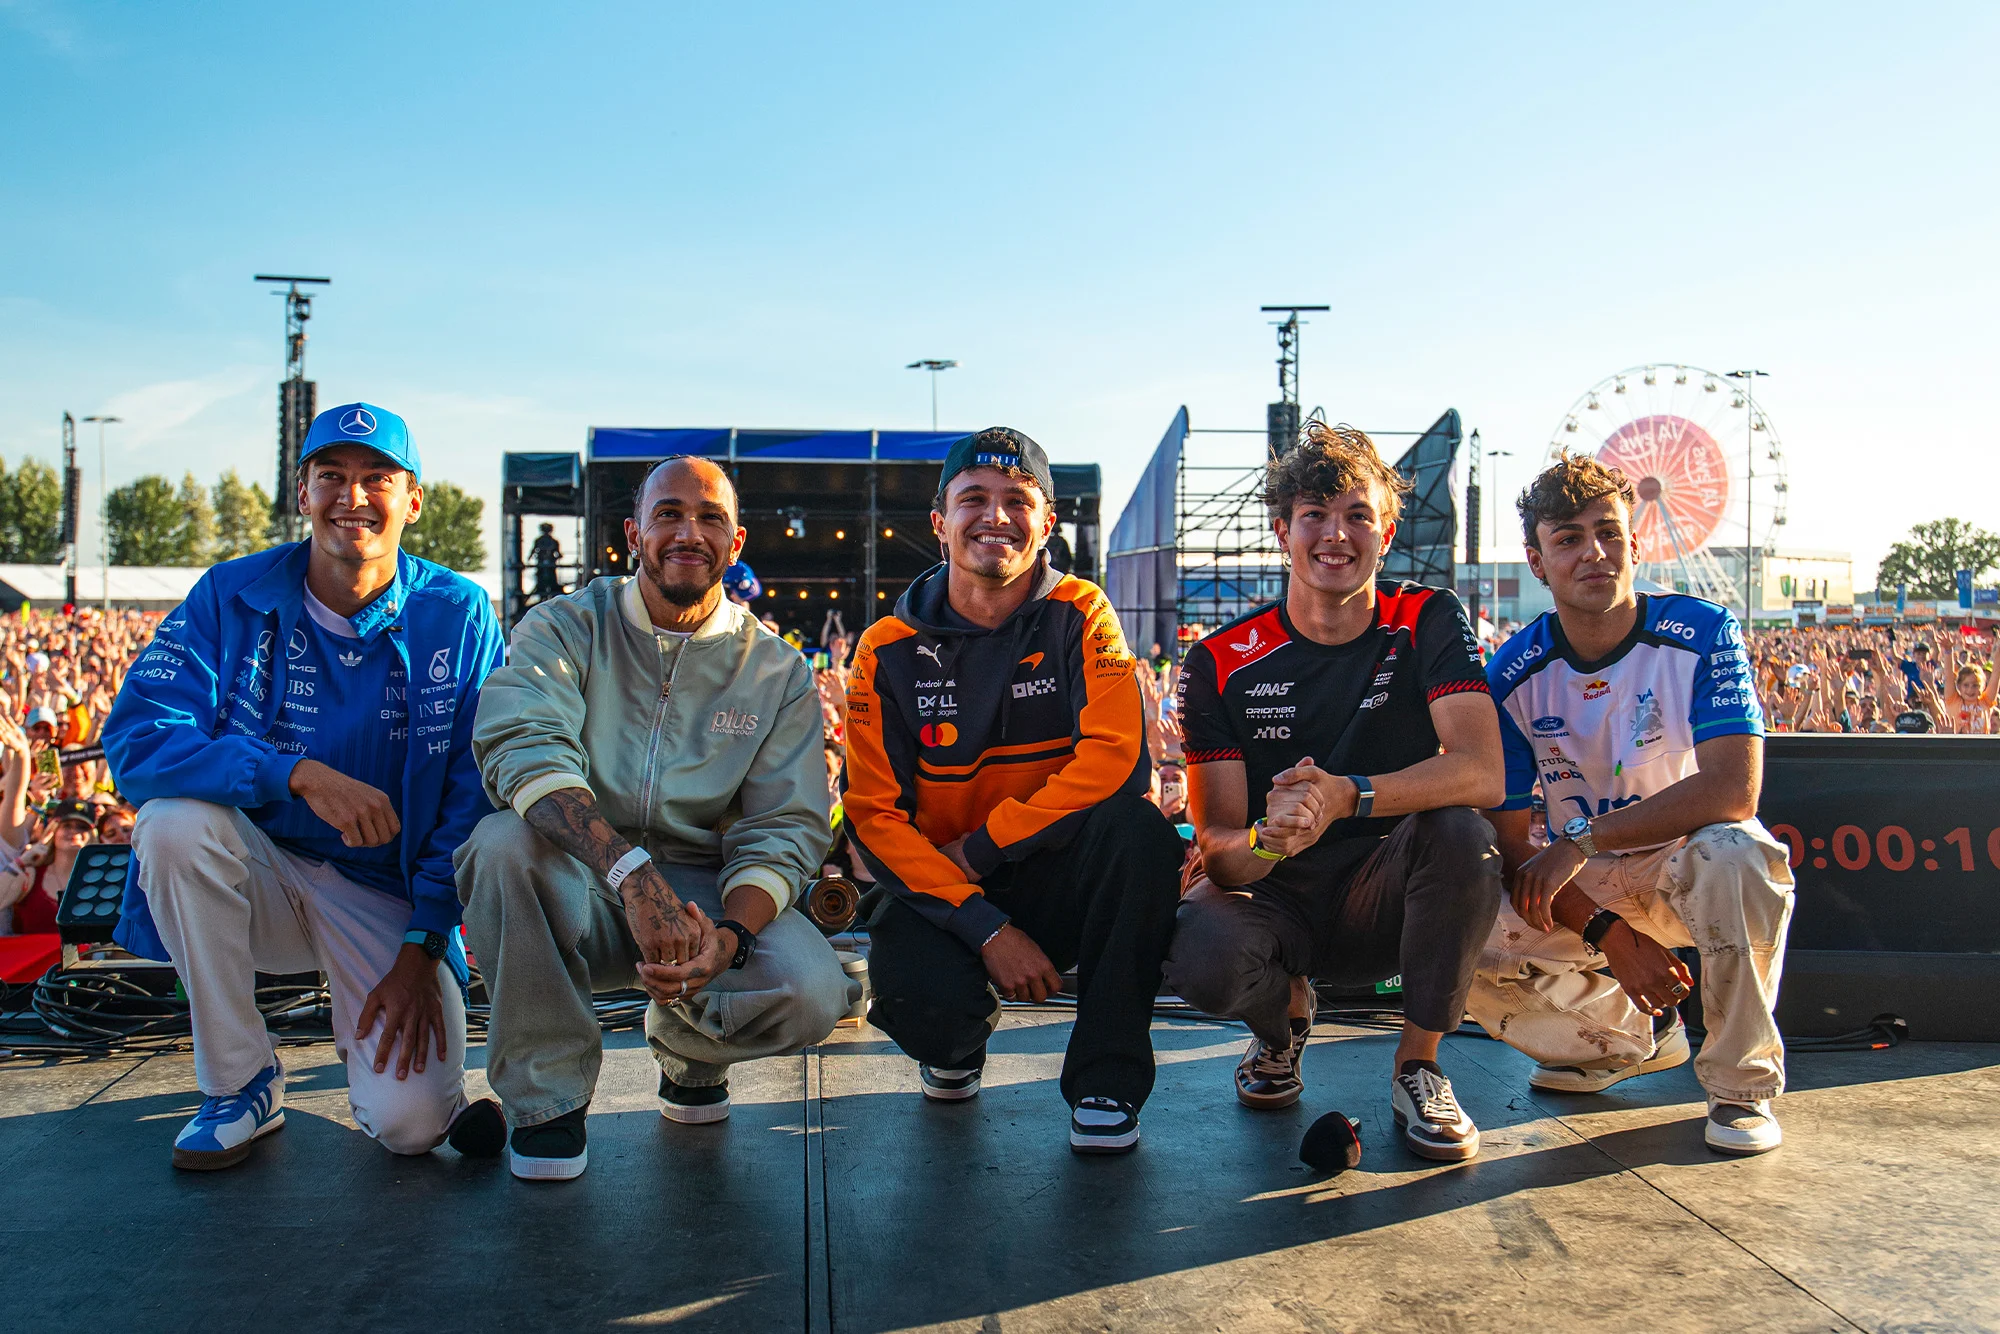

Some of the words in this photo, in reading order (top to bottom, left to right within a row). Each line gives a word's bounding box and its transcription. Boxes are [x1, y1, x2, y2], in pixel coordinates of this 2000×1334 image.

[1655, 618, 1696, 641] HUGO
[1502, 644, 1543, 682] HUGO
[1011, 677, 1057, 699] OKX
[1244, 681, 1295, 697] HAAS
[418, 698, 457, 718] INEO
[1711, 692, 1741, 708] Red
[709, 706, 759, 732] plus
[428, 740, 451, 755] HP
